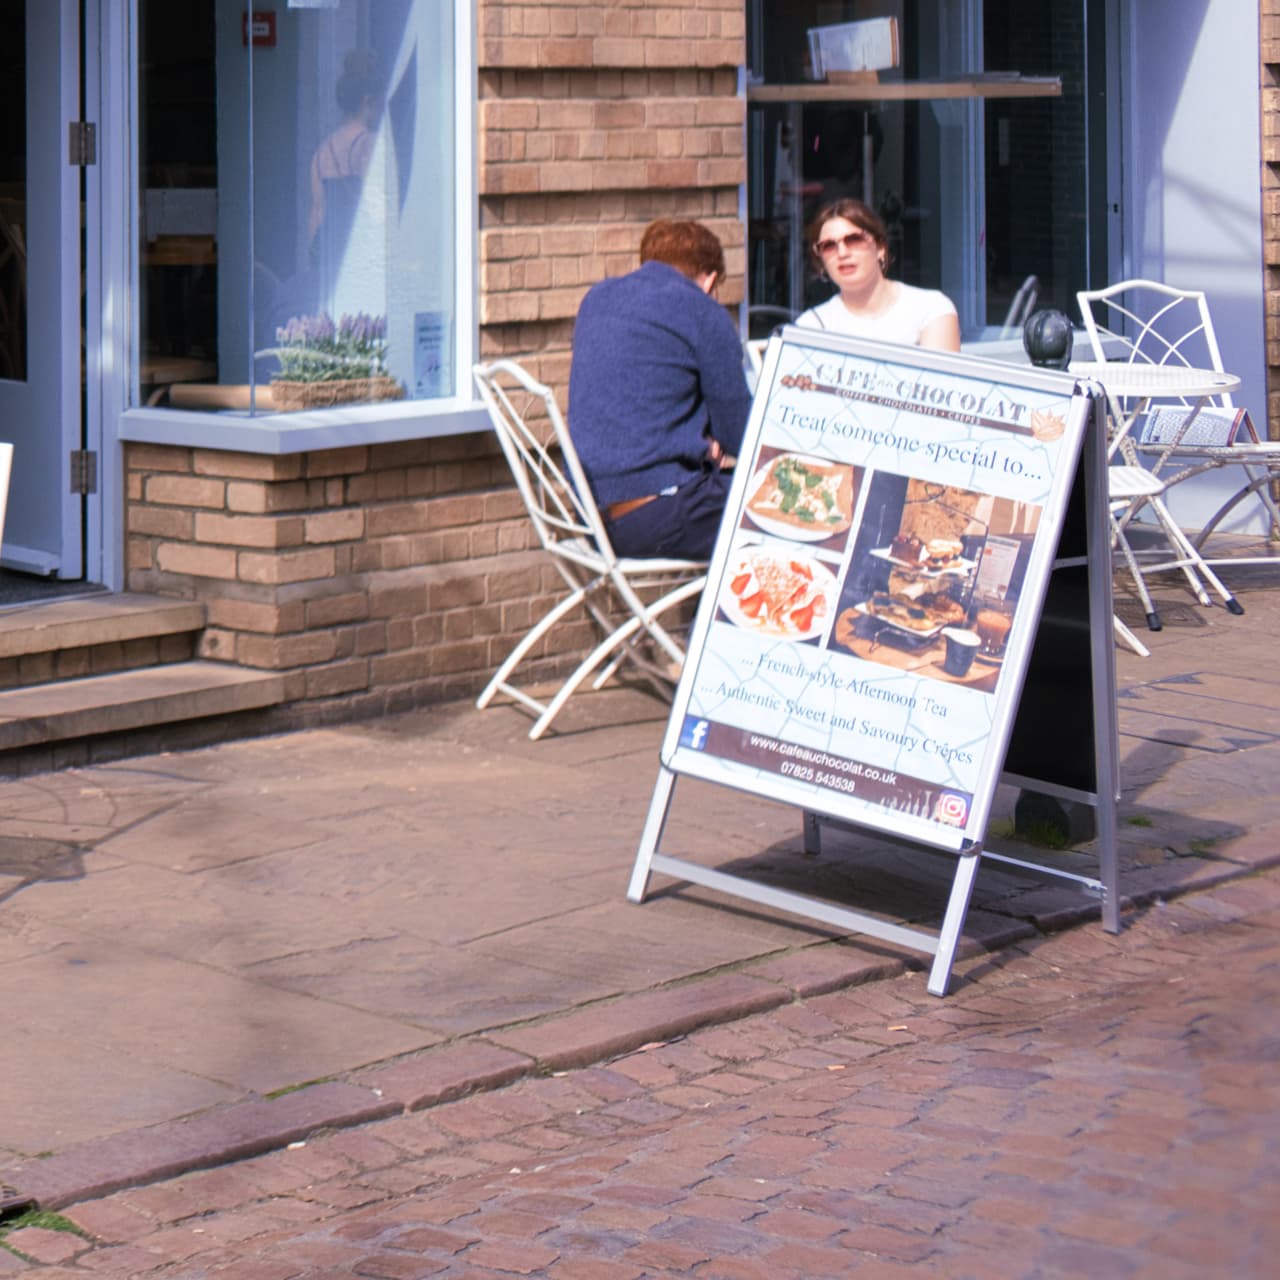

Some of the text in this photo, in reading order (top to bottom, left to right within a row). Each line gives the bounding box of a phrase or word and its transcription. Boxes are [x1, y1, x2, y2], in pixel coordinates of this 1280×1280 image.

[816, 363, 878, 391] CAFE
[896, 380, 1027, 422] CHOCOLAT
[778, 404, 1042, 480] Treat someone special to...
[757, 653, 843, 689] French-style
[845, 678, 917, 709] Afternoon
[922, 695, 948, 718] Tea
[716, 681, 782, 712] Authentic
[784, 698, 826, 724] Sweet
[829, 712, 857, 733] and
[858, 719, 920, 753] Savoury
[750, 733, 898, 786] www.cafeauchocolat.co.uk
[780, 762, 856, 794] 07825 543538
